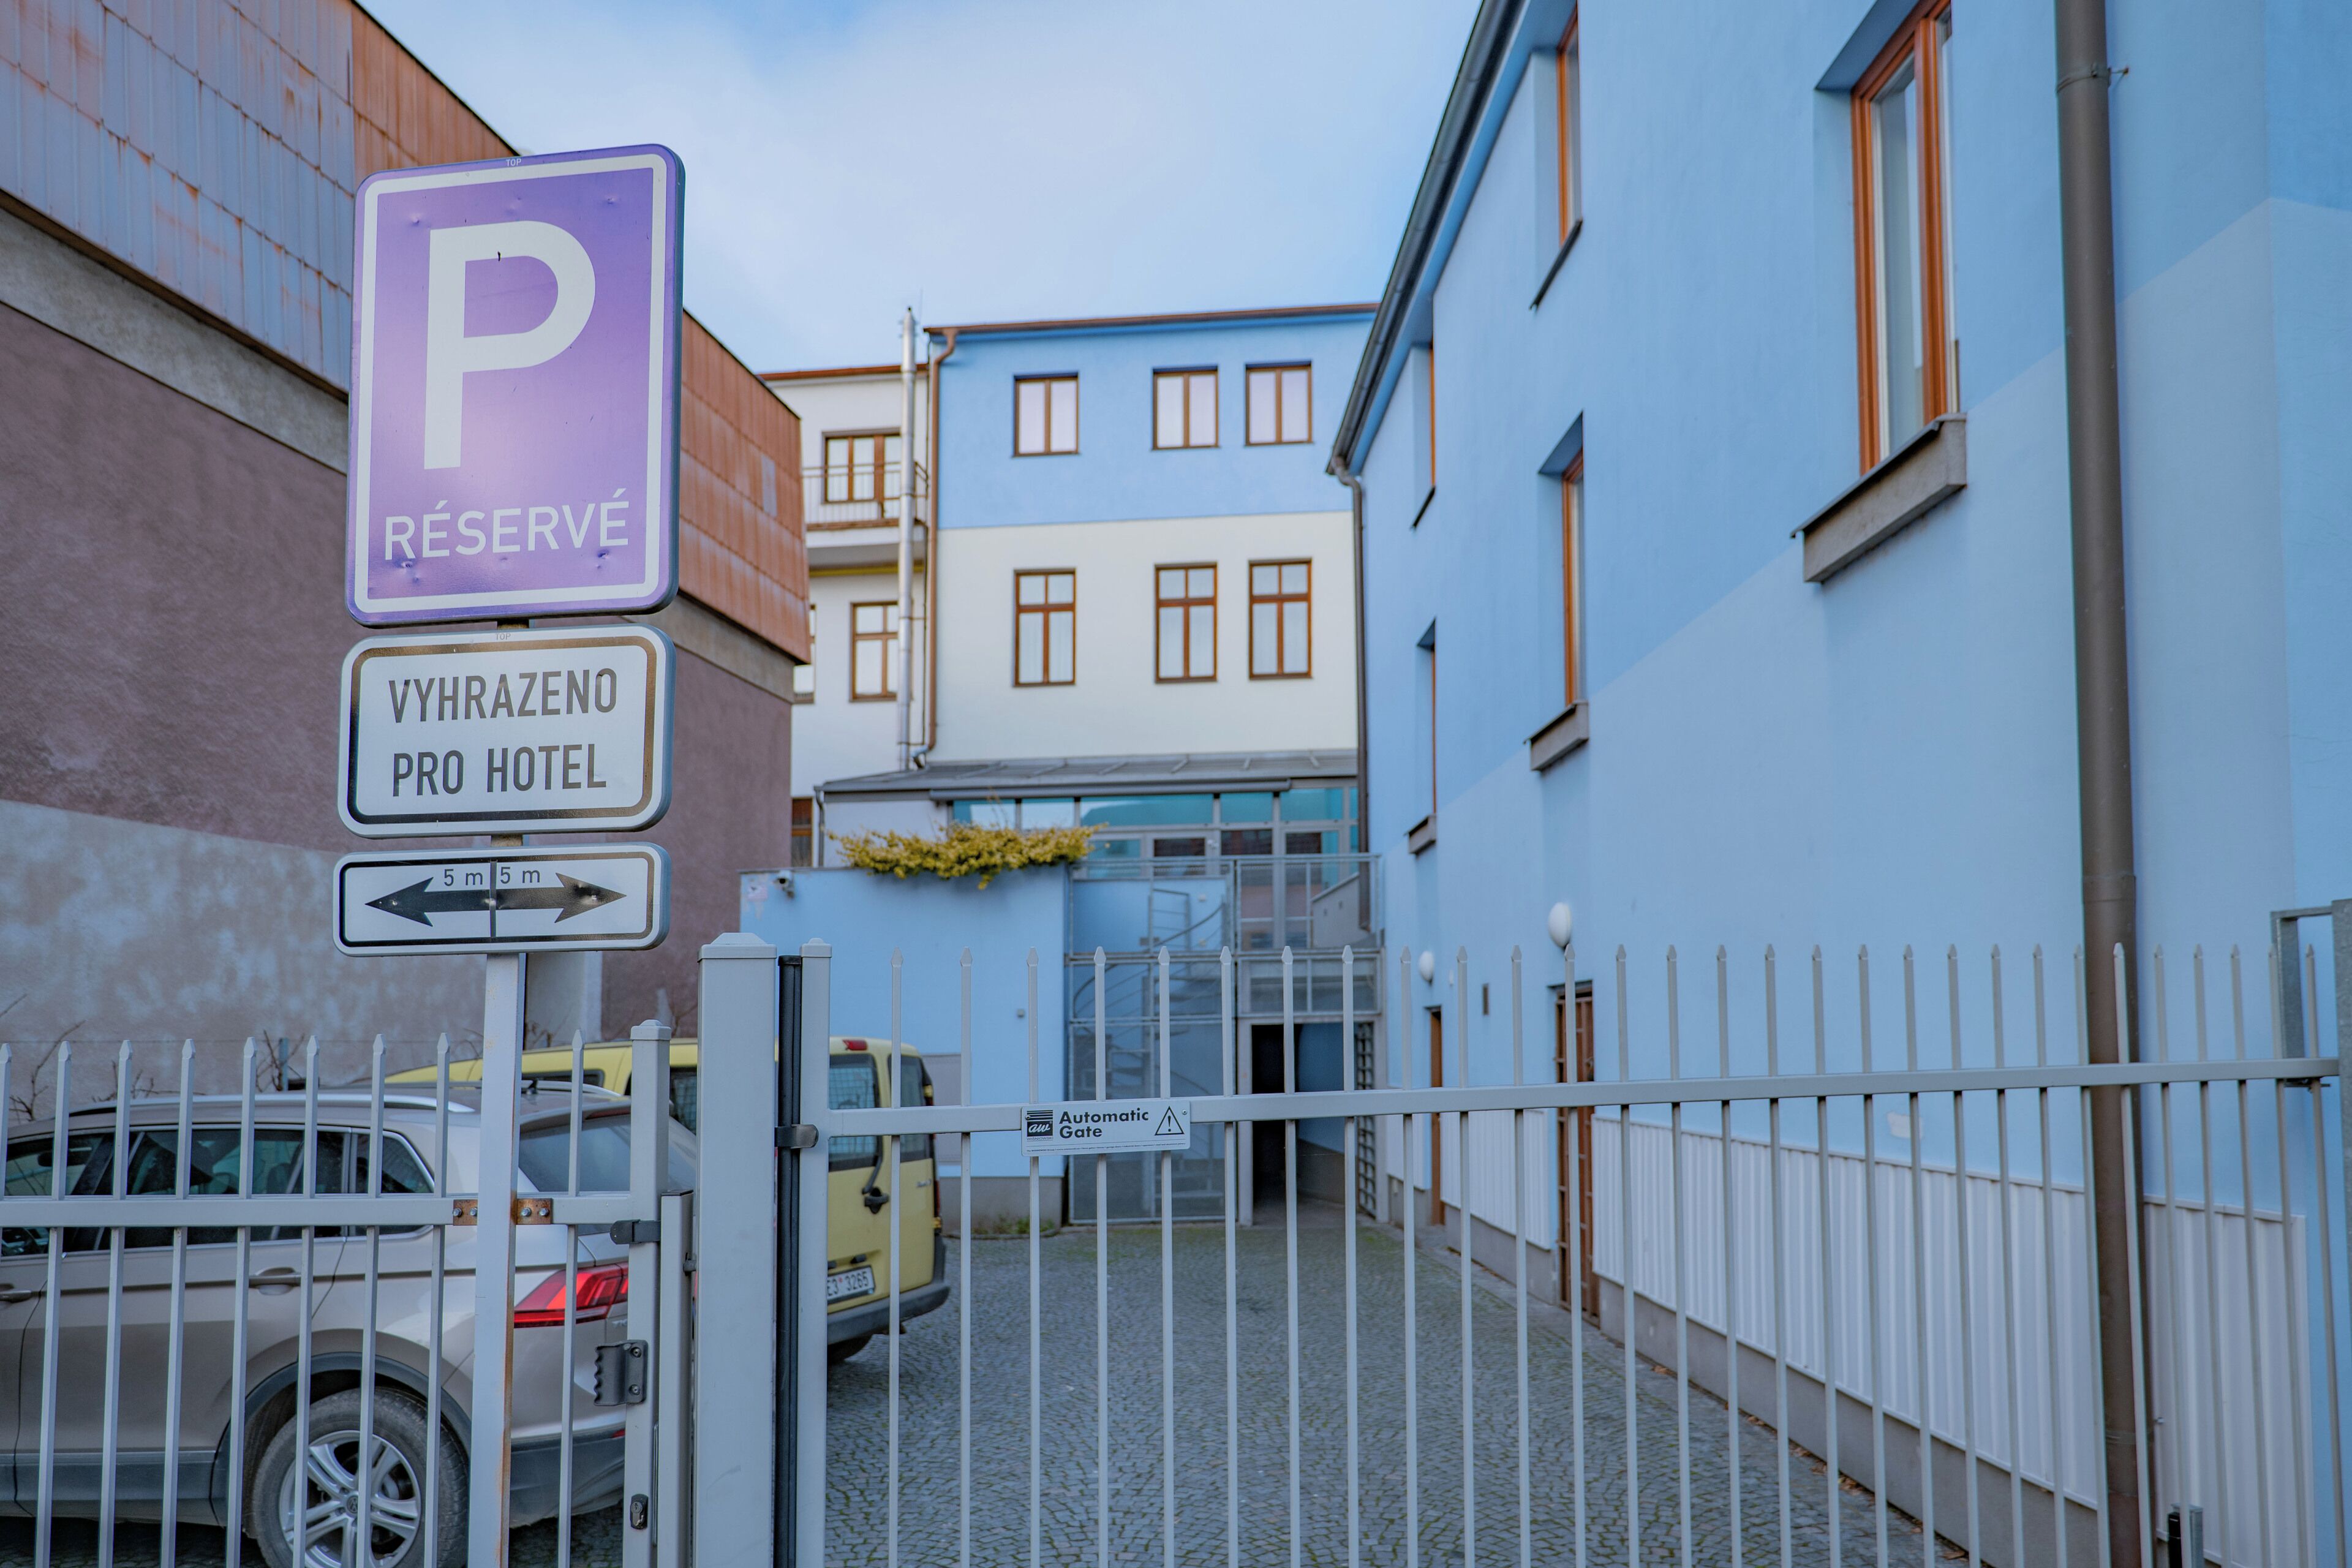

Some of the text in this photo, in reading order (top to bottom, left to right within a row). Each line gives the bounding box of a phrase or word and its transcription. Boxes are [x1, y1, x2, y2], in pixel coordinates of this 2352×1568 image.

[506, 158, 522, 167] TOP
[424, 220, 596, 470] P
[385, 488, 630, 560] RÉSERVÉ
[496, 631, 511, 641] TOP
[388, 668, 617, 723] VYHRAZENO
[393, 744, 607, 797] PRO HOTEL
[444, 869, 483, 886] 5 m
[500, 867, 540, 884] 5 m
[1059, 1107, 1149, 1125] Automatic
[1059, 1125, 1102, 1139] Gate
